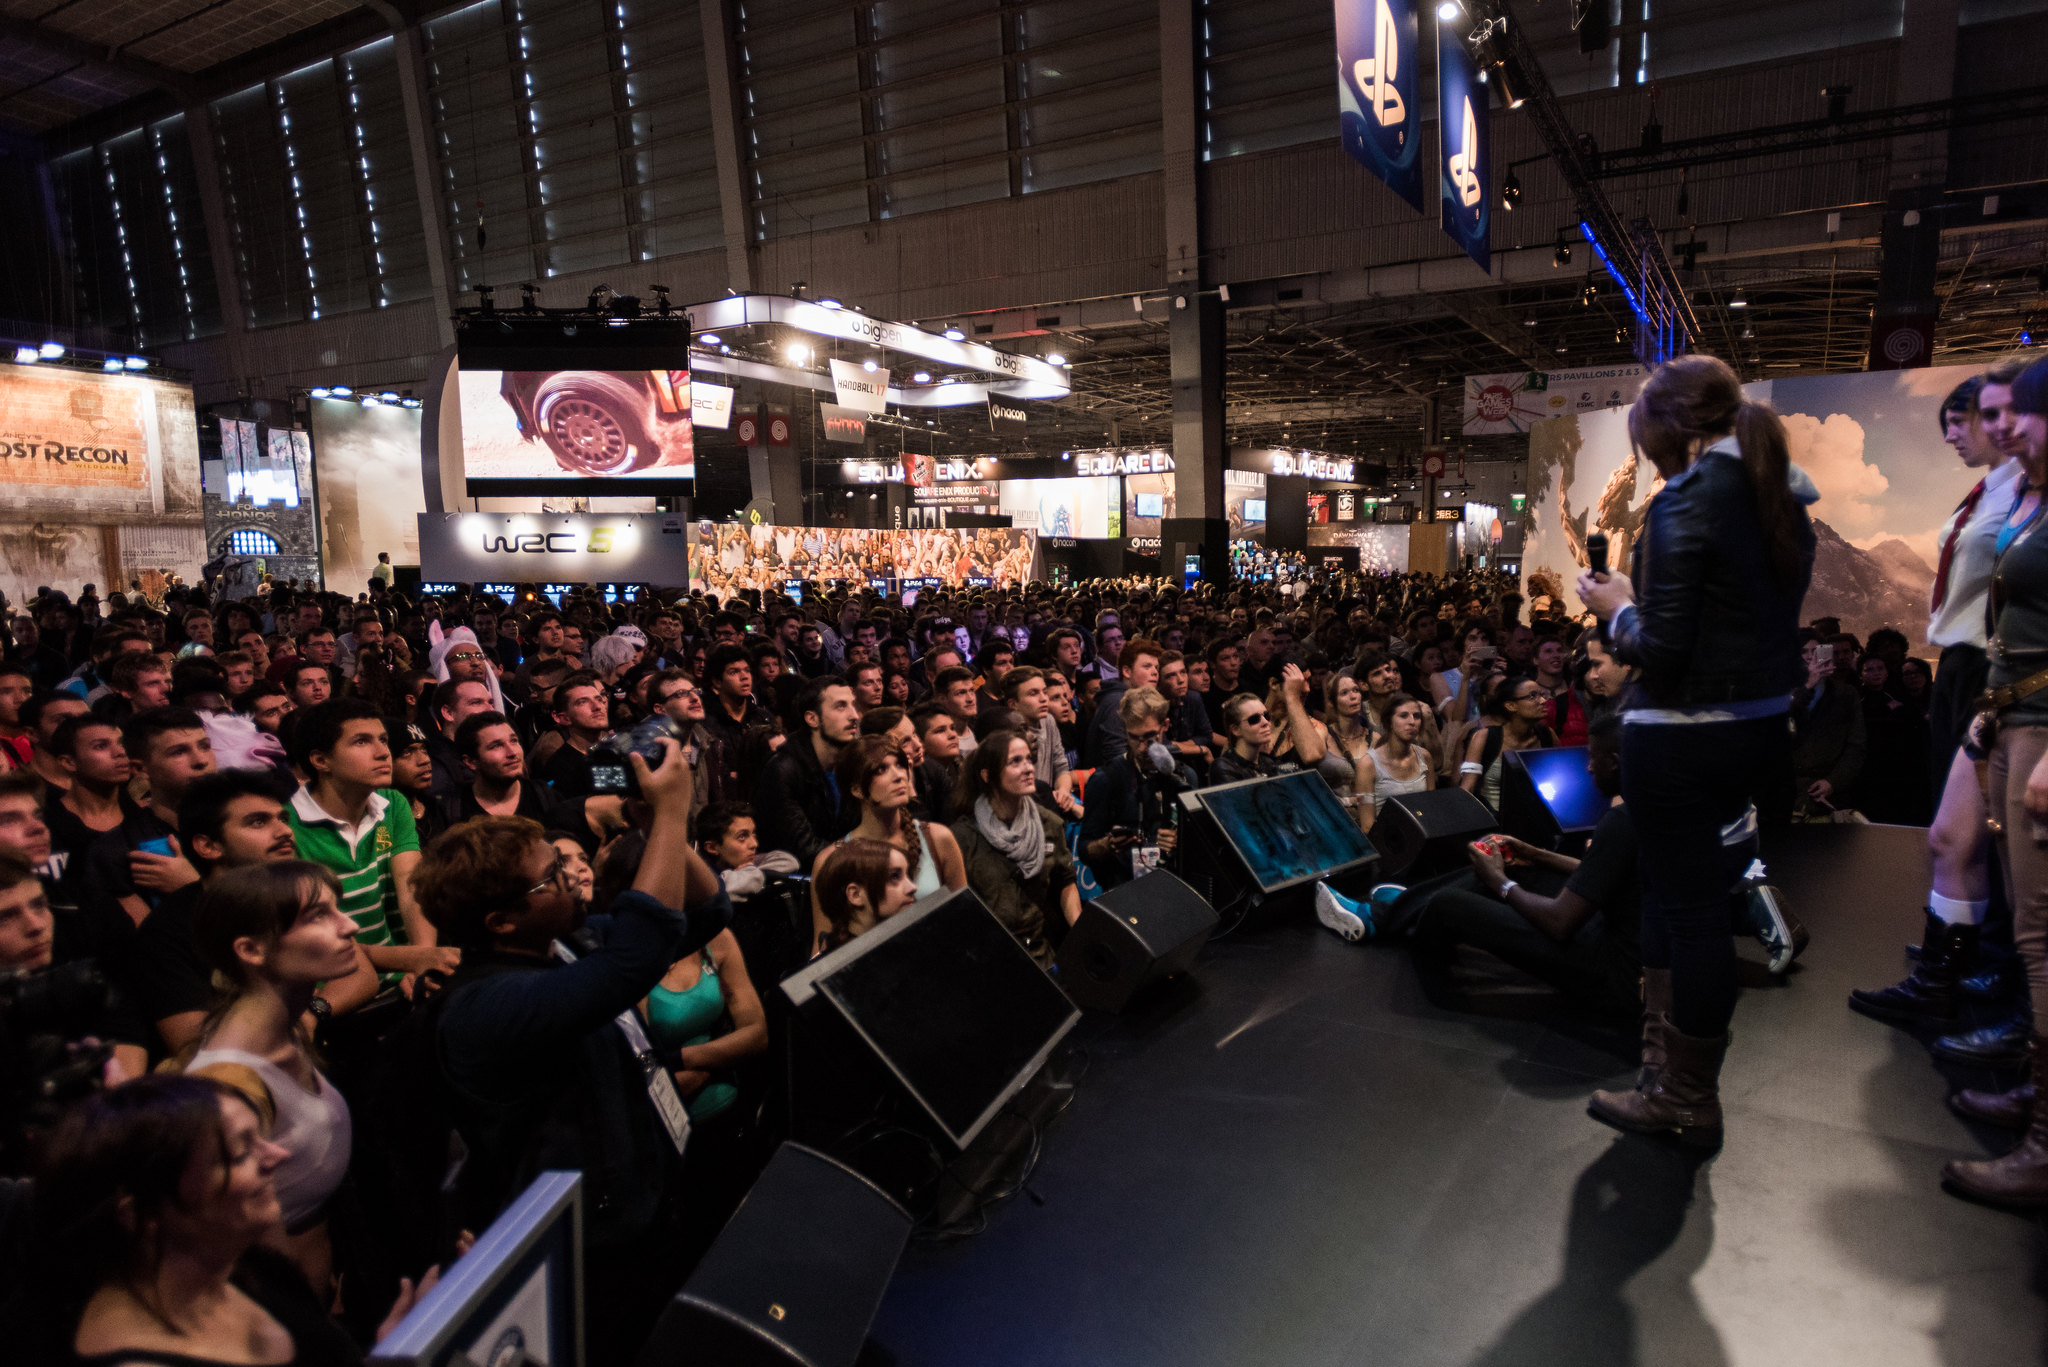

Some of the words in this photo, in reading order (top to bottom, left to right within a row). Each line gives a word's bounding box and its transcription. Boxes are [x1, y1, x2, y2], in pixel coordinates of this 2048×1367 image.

[1564, 370, 1616, 380] PAVILLONS
[1618, 369, 1624, 377] 2
[837, 379, 873, 394] HANDBALL
[877, 384, 886, 396] 17
[692, 399, 712, 410] RC
[1477, 398, 1511, 408] GAMES
[1001, 407, 1026, 421] nacon
[45, 440, 128, 466] RECON
[1077, 454, 1150, 476] SQUARE
[1152, 453, 1175, 472] EN
[1273, 455, 1326, 479] SQUARE
[858, 464, 906, 482] SQUA
[914, 487, 938, 496] SQUARE
[939, 487, 953, 496] ENIX
[237, 503, 259, 511] FOR
[215, 510, 277, 522] HONOR
[482, 532, 577, 553] WRC
[1058, 539, 1077, 548] nacon
